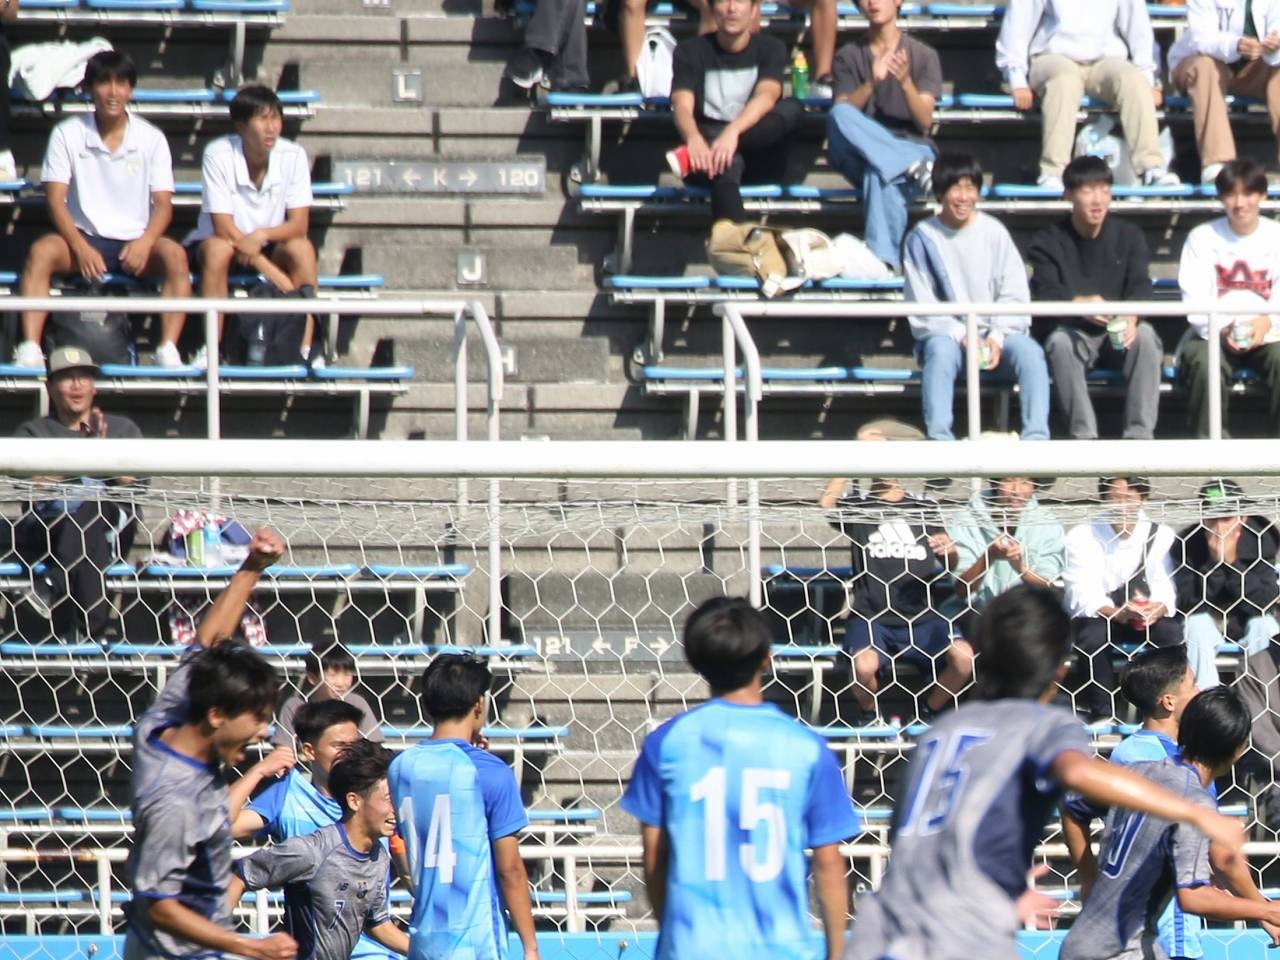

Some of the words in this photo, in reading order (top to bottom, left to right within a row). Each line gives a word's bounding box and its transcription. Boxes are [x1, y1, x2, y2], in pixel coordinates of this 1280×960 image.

[398, 74, 417, 99] L
[344, 168, 382, 187] 121
[433, 168, 448, 186] K
[499, 168, 538, 187] 120
[462, 255, 482, 281] J
[533, 636, 571, 654] 121
[624, 636, 640, 654] F
[899, 727, 998, 836] 15
[399, 794, 457, 885] 14
[690, 767, 791, 883] 15
[327, 899, 347, 931] 7
